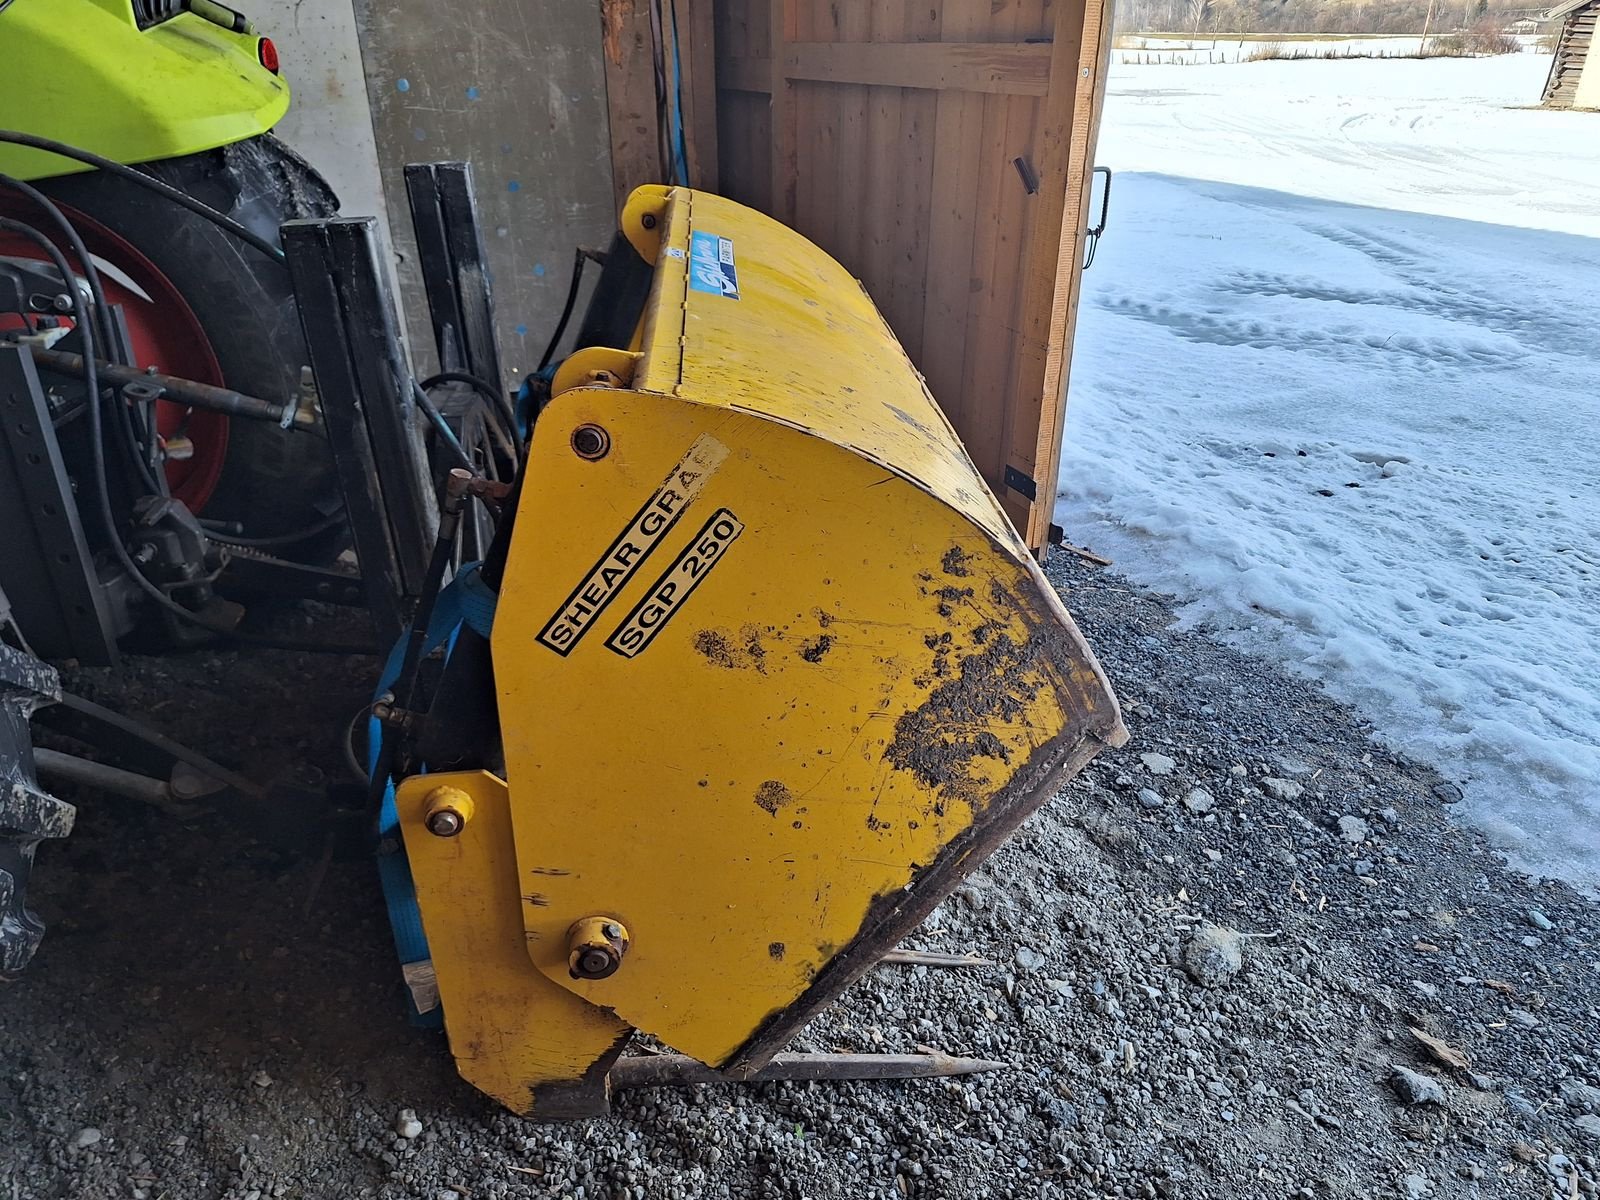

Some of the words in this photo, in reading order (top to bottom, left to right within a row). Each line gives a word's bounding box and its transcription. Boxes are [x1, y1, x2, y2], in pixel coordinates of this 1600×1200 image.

[551, 543, 642, 645] SHEAR
[620, 582, 677, 650] SGP
[682, 520, 735, 578] 250
